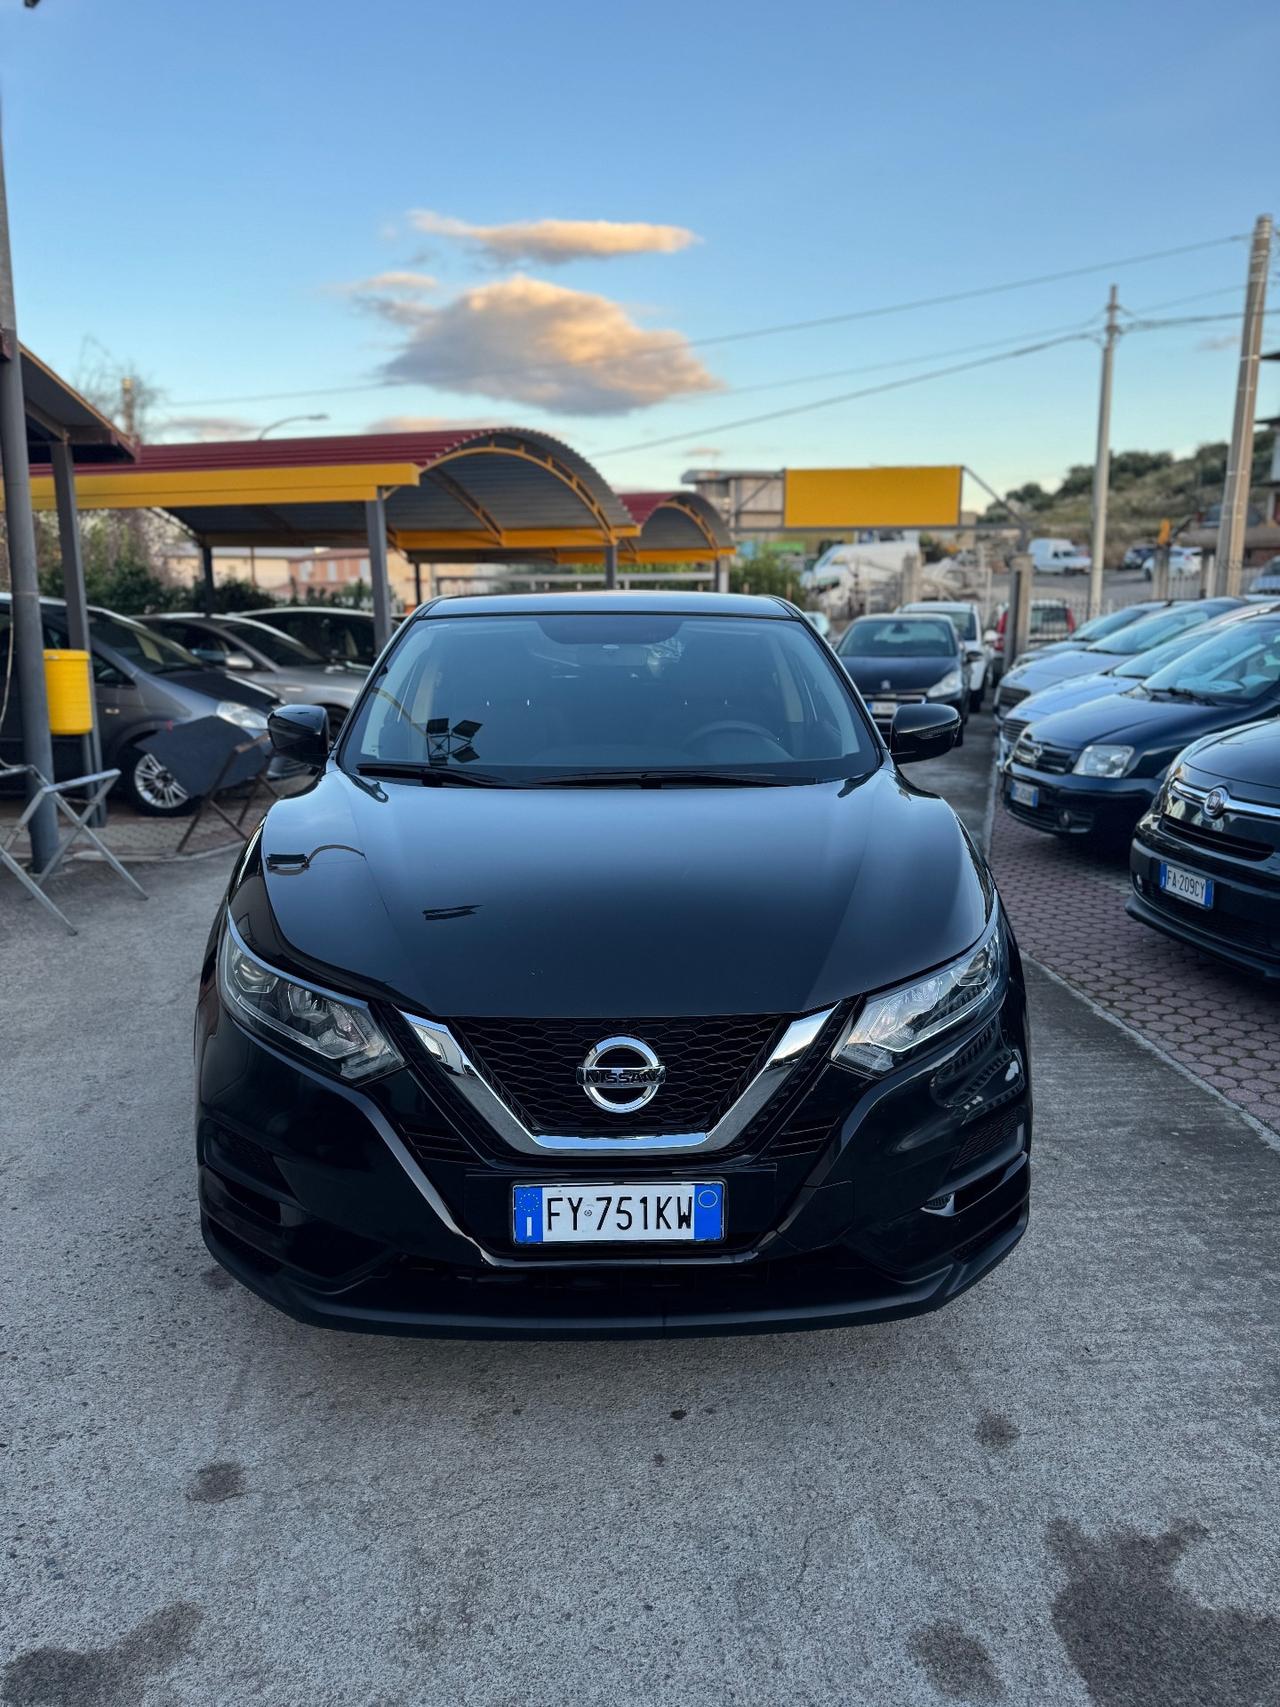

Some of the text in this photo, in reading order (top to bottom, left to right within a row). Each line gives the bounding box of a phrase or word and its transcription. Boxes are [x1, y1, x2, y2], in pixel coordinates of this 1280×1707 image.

[1167, 869, 1177, 888] FA
[586, 1070, 659, 1085] NISSAN
[547, 1196, 693, 1231] FY 751KW
